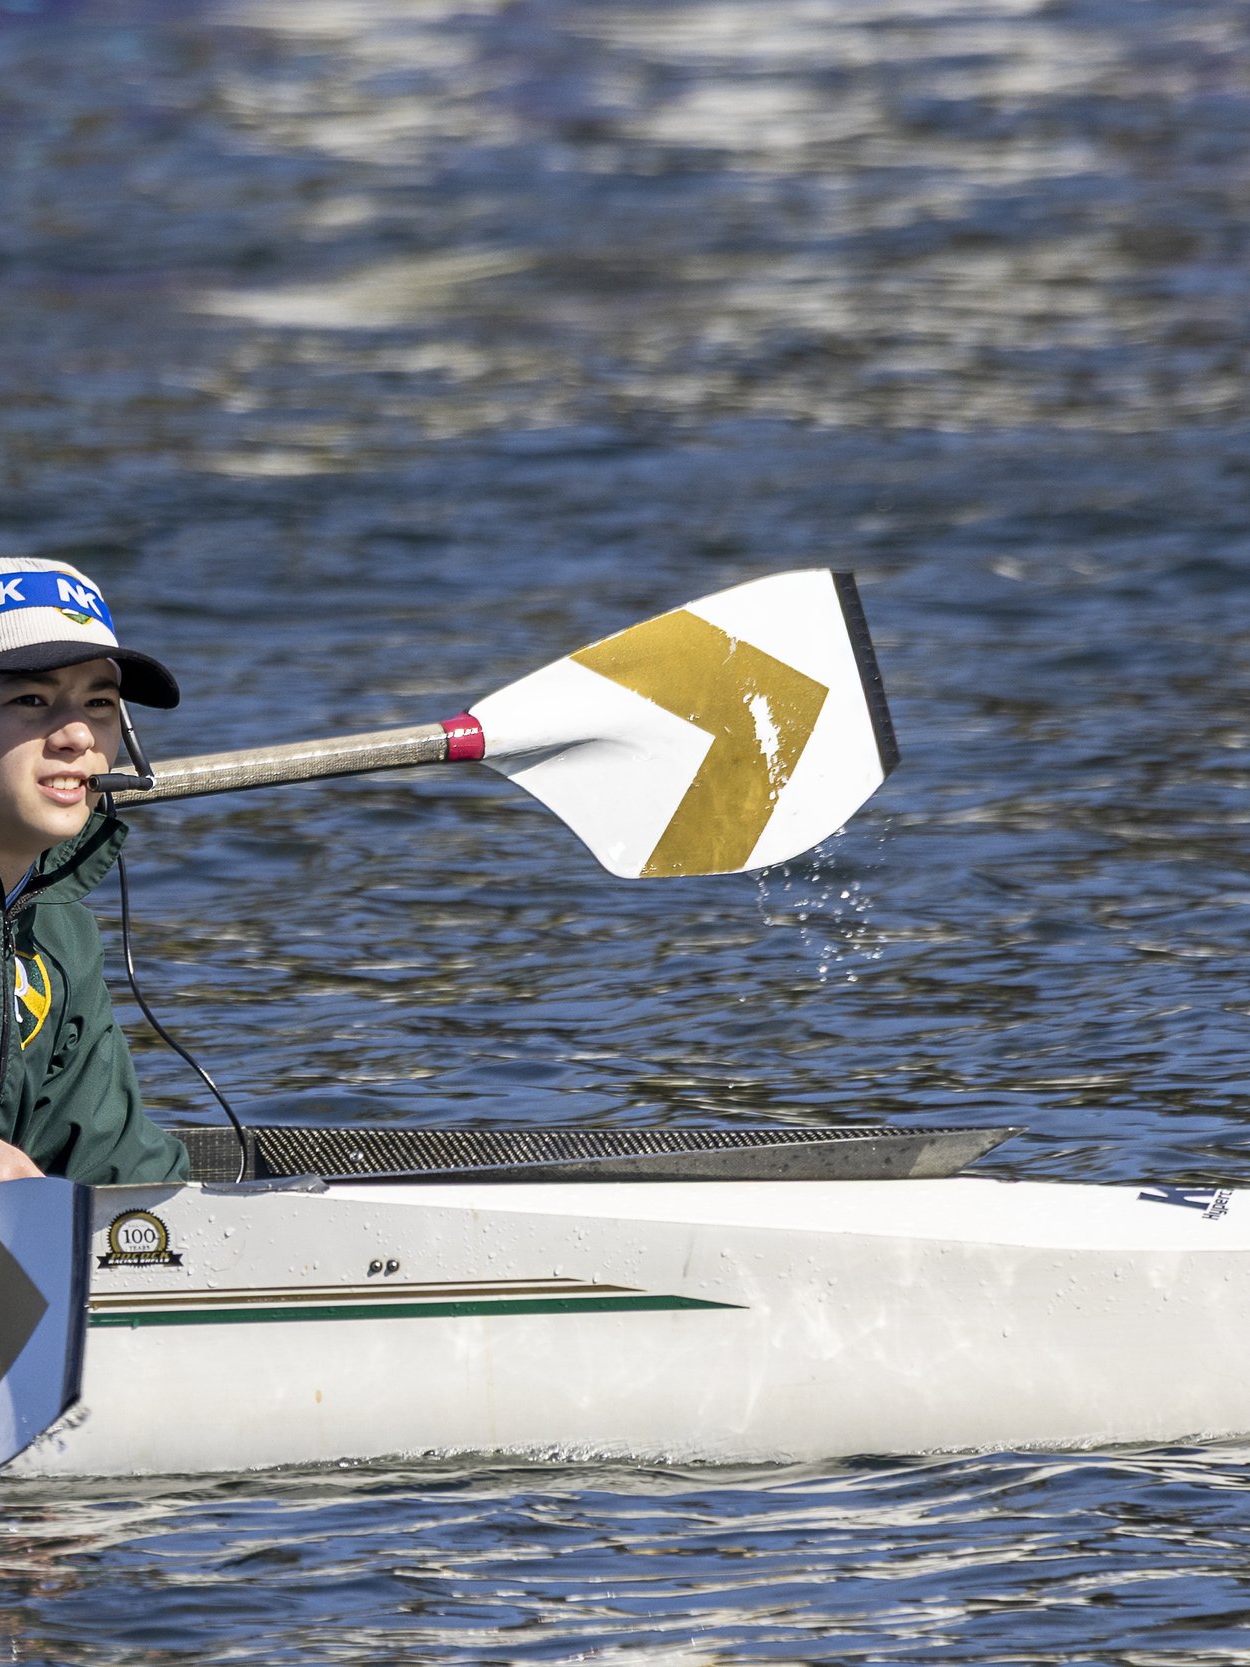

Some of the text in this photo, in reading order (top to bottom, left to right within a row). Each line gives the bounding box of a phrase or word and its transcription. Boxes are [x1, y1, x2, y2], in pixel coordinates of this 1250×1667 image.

[56, 578, 103, 618] NK
[1201, 1188, 1234, 1221] Hyperc
[123, 1228, 156, 1244] 100
[111, 1252, 170, 1260] POCOCK
